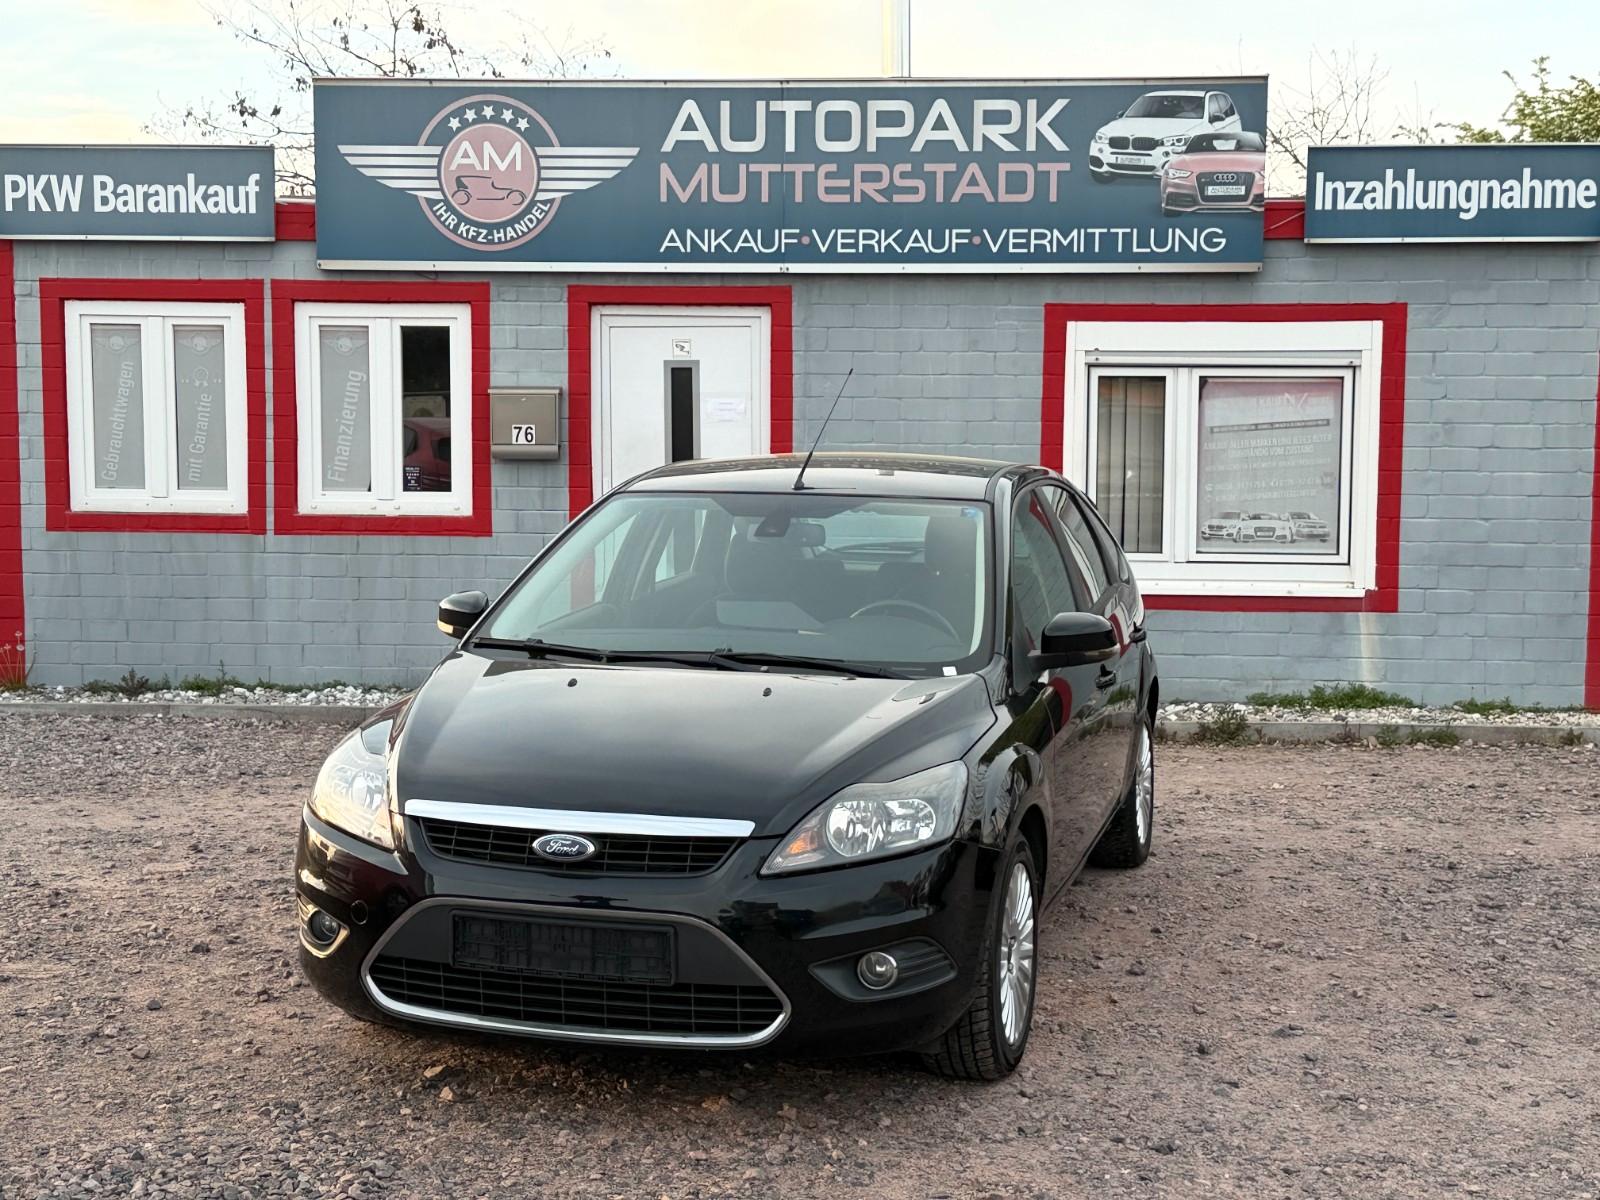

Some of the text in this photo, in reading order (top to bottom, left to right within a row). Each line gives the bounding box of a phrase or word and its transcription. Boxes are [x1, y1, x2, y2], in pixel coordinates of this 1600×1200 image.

[660, 98, 1071, 152] AUTOPARK
[450, 140, 522, 172] AM
[4, 173, 260, 214] PKW Barankauf
[659, 162, 1071, 203] MUTTERSTADT
[1315, 167, 1598, 220] Inzahlungnahme
[432, 201, 551, 243] IHR KFZ-HANDEL
[660, 227, 1227, 253] ANKAUF VERKAUF VERMITTLUNG
[102, 360, 135, 481] Gebrauchtwagen
[187, 393, 213, 482] mit Garantie
[328, 369, 367, 482] Finanzierung
[513, 426, 534, 443] 76
[546, 839, 580, 855] Ford
